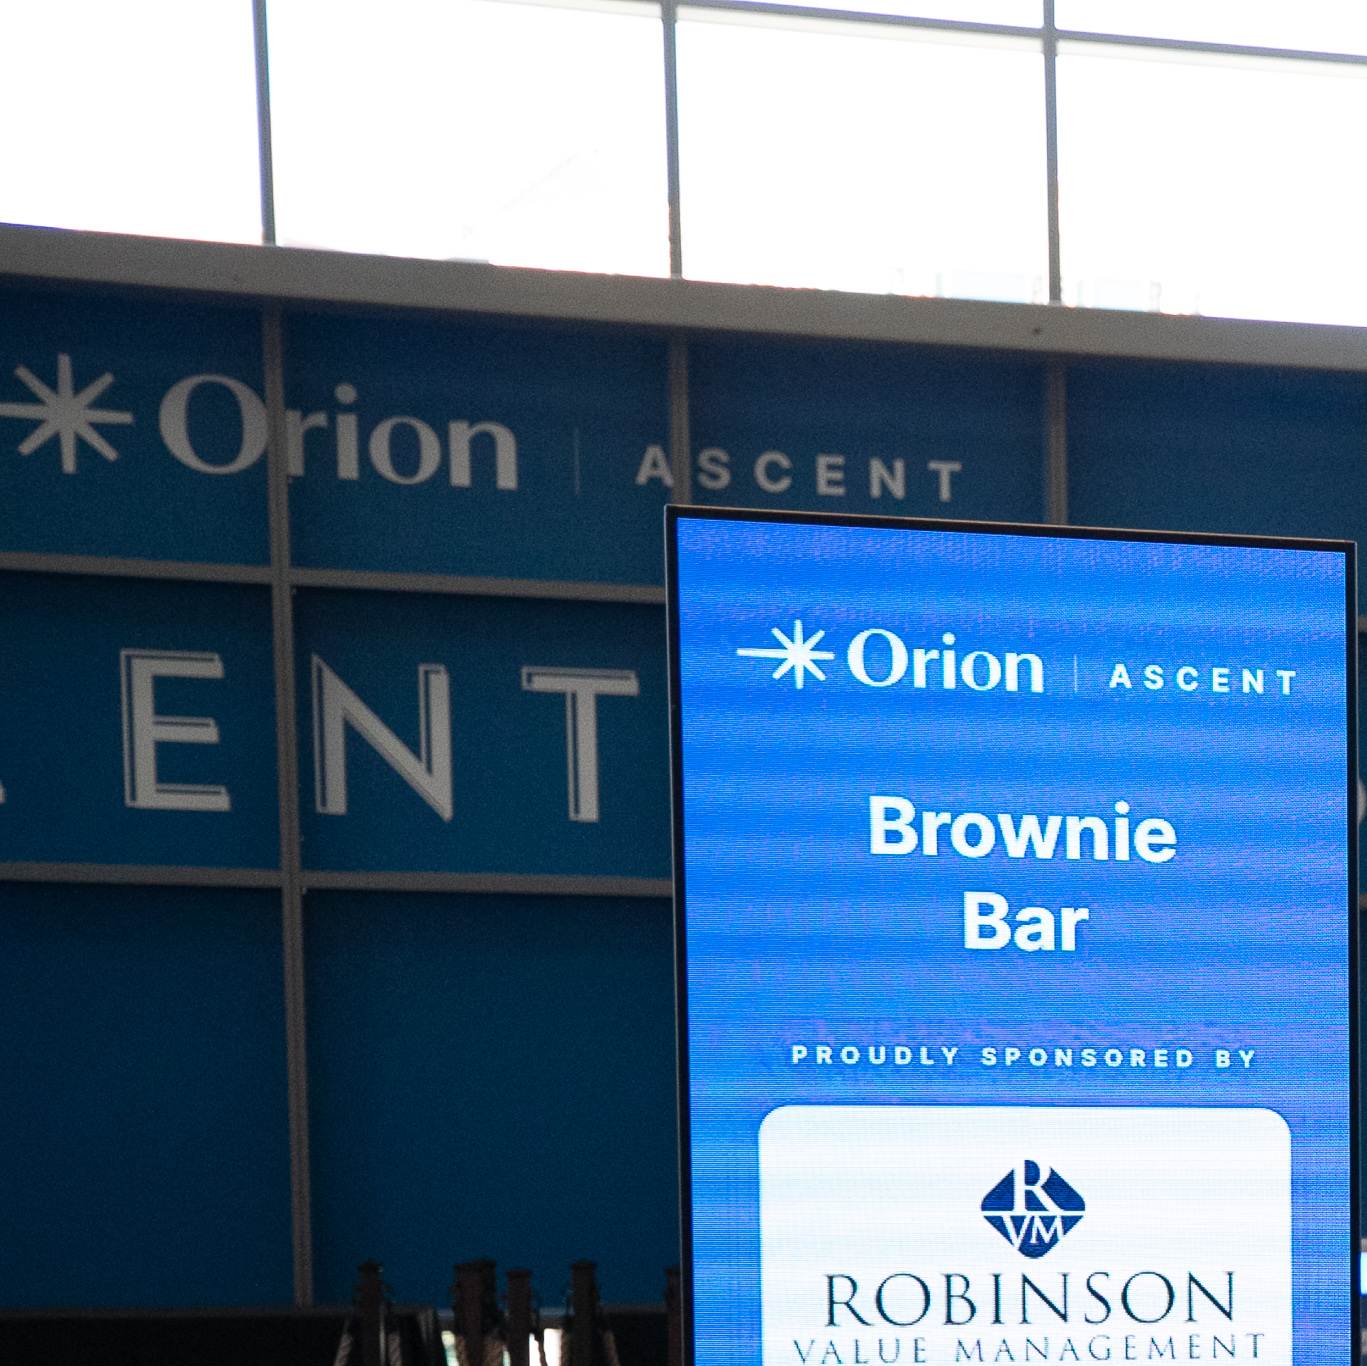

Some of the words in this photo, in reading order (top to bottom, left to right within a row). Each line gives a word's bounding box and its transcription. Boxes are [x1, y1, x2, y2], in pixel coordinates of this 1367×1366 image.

[158, 373, 518, 491] Orion
[635, 443, 963, 503] ASCENT
[846, 627, 1045, 693] Orion
[1108, 662, 1297, 696] ASCENT
[868, 794, 1178, 863] Brownie
[963, 890, 1090, 952] Bar
[791, 1044, 960, 1067] PROUDLY
[980, 1045, 1195, 1069] SPONSORED
[1215, 1047, 1258, 1070] BY
[824, 1269, 1238, 1329] ROBINSON
[791, 1335, 928, 1366] VALUE
[955, 1331, 1268, 1364] MANAGEMENT
